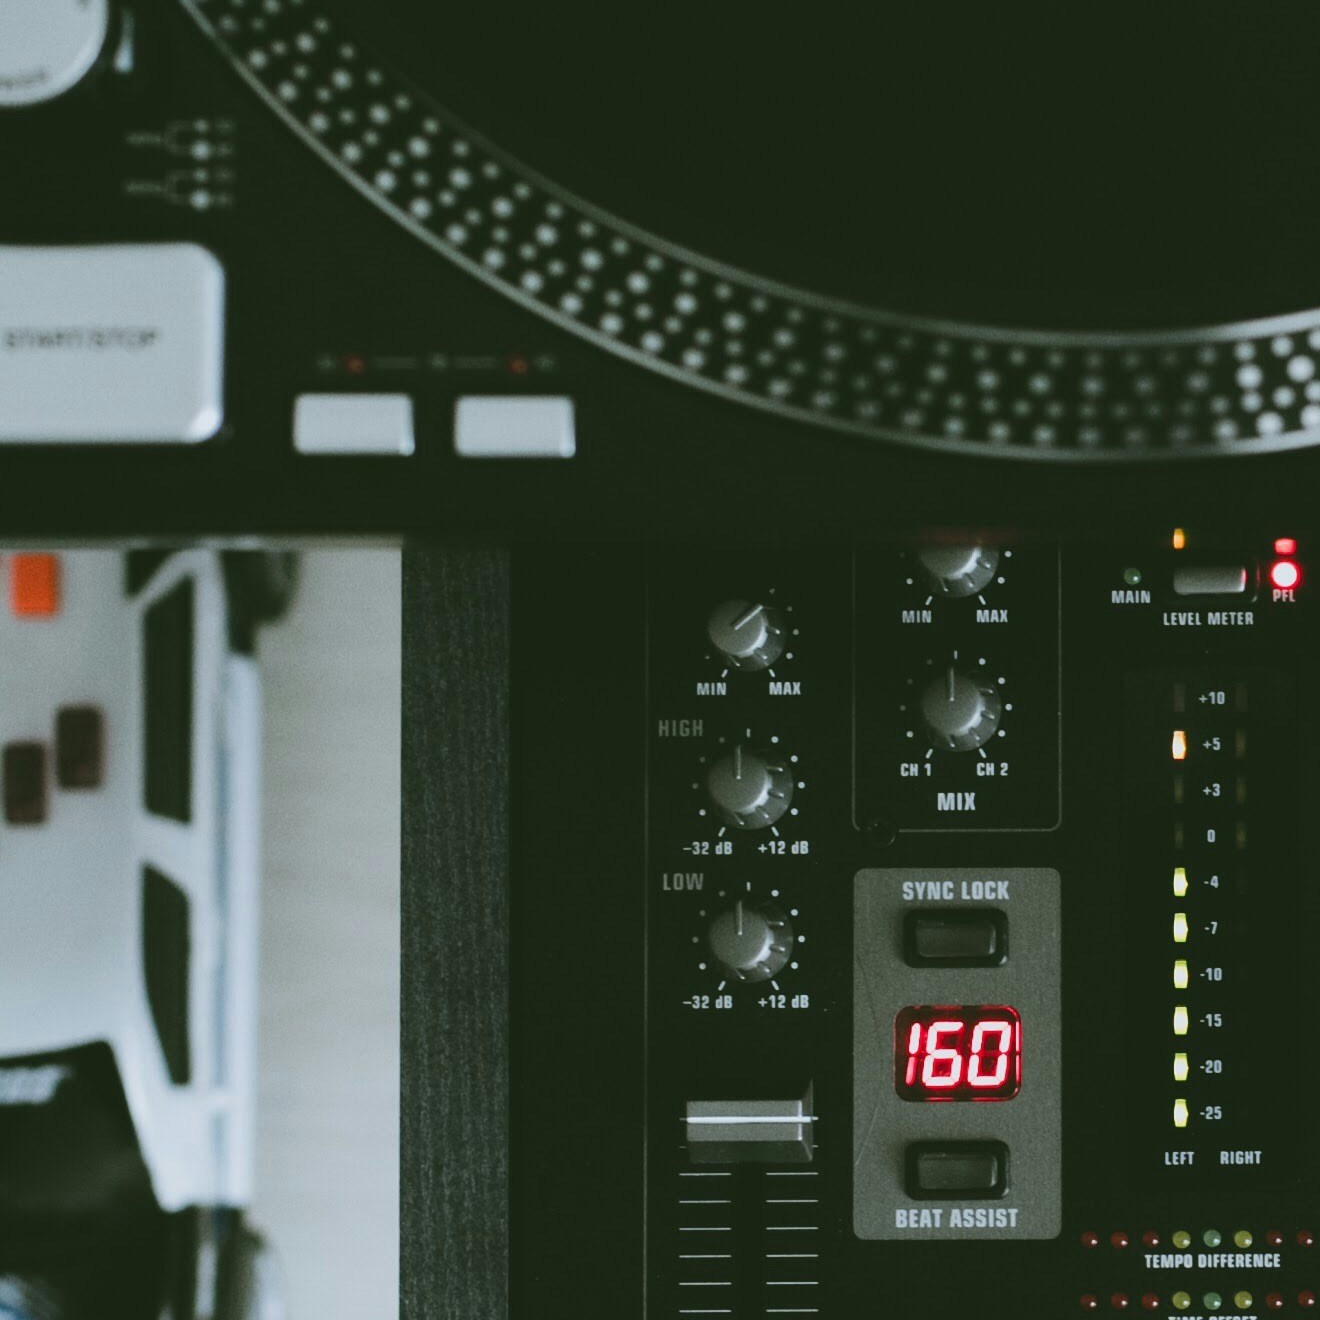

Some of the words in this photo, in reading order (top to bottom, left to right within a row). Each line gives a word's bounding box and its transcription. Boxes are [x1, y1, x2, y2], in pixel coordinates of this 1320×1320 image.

[1111, 589, 1151, 604] MAIN
[1272, 588, 1296, 603] PFL
[901, 609, 932, 624] MIN
[976, 609, 1009, 623] MAX
[1163, 611, 1202, 626] LEVEL
[1207, 611, 1254, 626] METER
[696, 682, 727, 696] MIN
[768, 681, 802, 696] MAX
[1198, 691, 1226, 705] +10
[658, 719, 704, 738] HIGH
[1202, 737, 1221, 751] +5
[900, 762, 919, 777] CH
[923, 762, 932, 777] 1
[976, 762, 995, 777] CH
[999, 762, 1009, 777] 2
[1202, 782, 1221, 797] +3
[937, 792, 976, 811] MIX
[1206, 828, 1216, 843] 0
[682, 841, 710, 856] -32
[714, 840, 733, 855] dB
[757, 840, 786, 855] +12
[790, 840, 809, 855] dB
[662, 872, 704, 891] LOW
[1203, 875, 1220, 889] -4
[902, 880, 955, 901] SYNC
[961, 880, 1010, 901] LOCK
[1199, 967, 1223, 982] -10
[682, 994, 710, 1010] -32
[714, 994, 733, 1009] dB
[757, 994, 787, 1009] +12
[791, 994, 810, 1009] dB
[1199, 1013, 1223, 1028] -15
[905, 1021, 1012, 1088] 160
[1199, 1059, 1223, 1074] -20
[1199, 1105, 1223, 1120] -25
[1164, 1151, 1195, 1166] LEFT
[1219, 1150, 1263, 1165] RIGHT
[895, 1208, 944, 1229] BEAT
[949, 1208, 1019, 1228] ASSIST
[1144, 1253, 1194, 1269] TEMPO
[1197, 1253, 1281, 1269] DIFFERENCE
